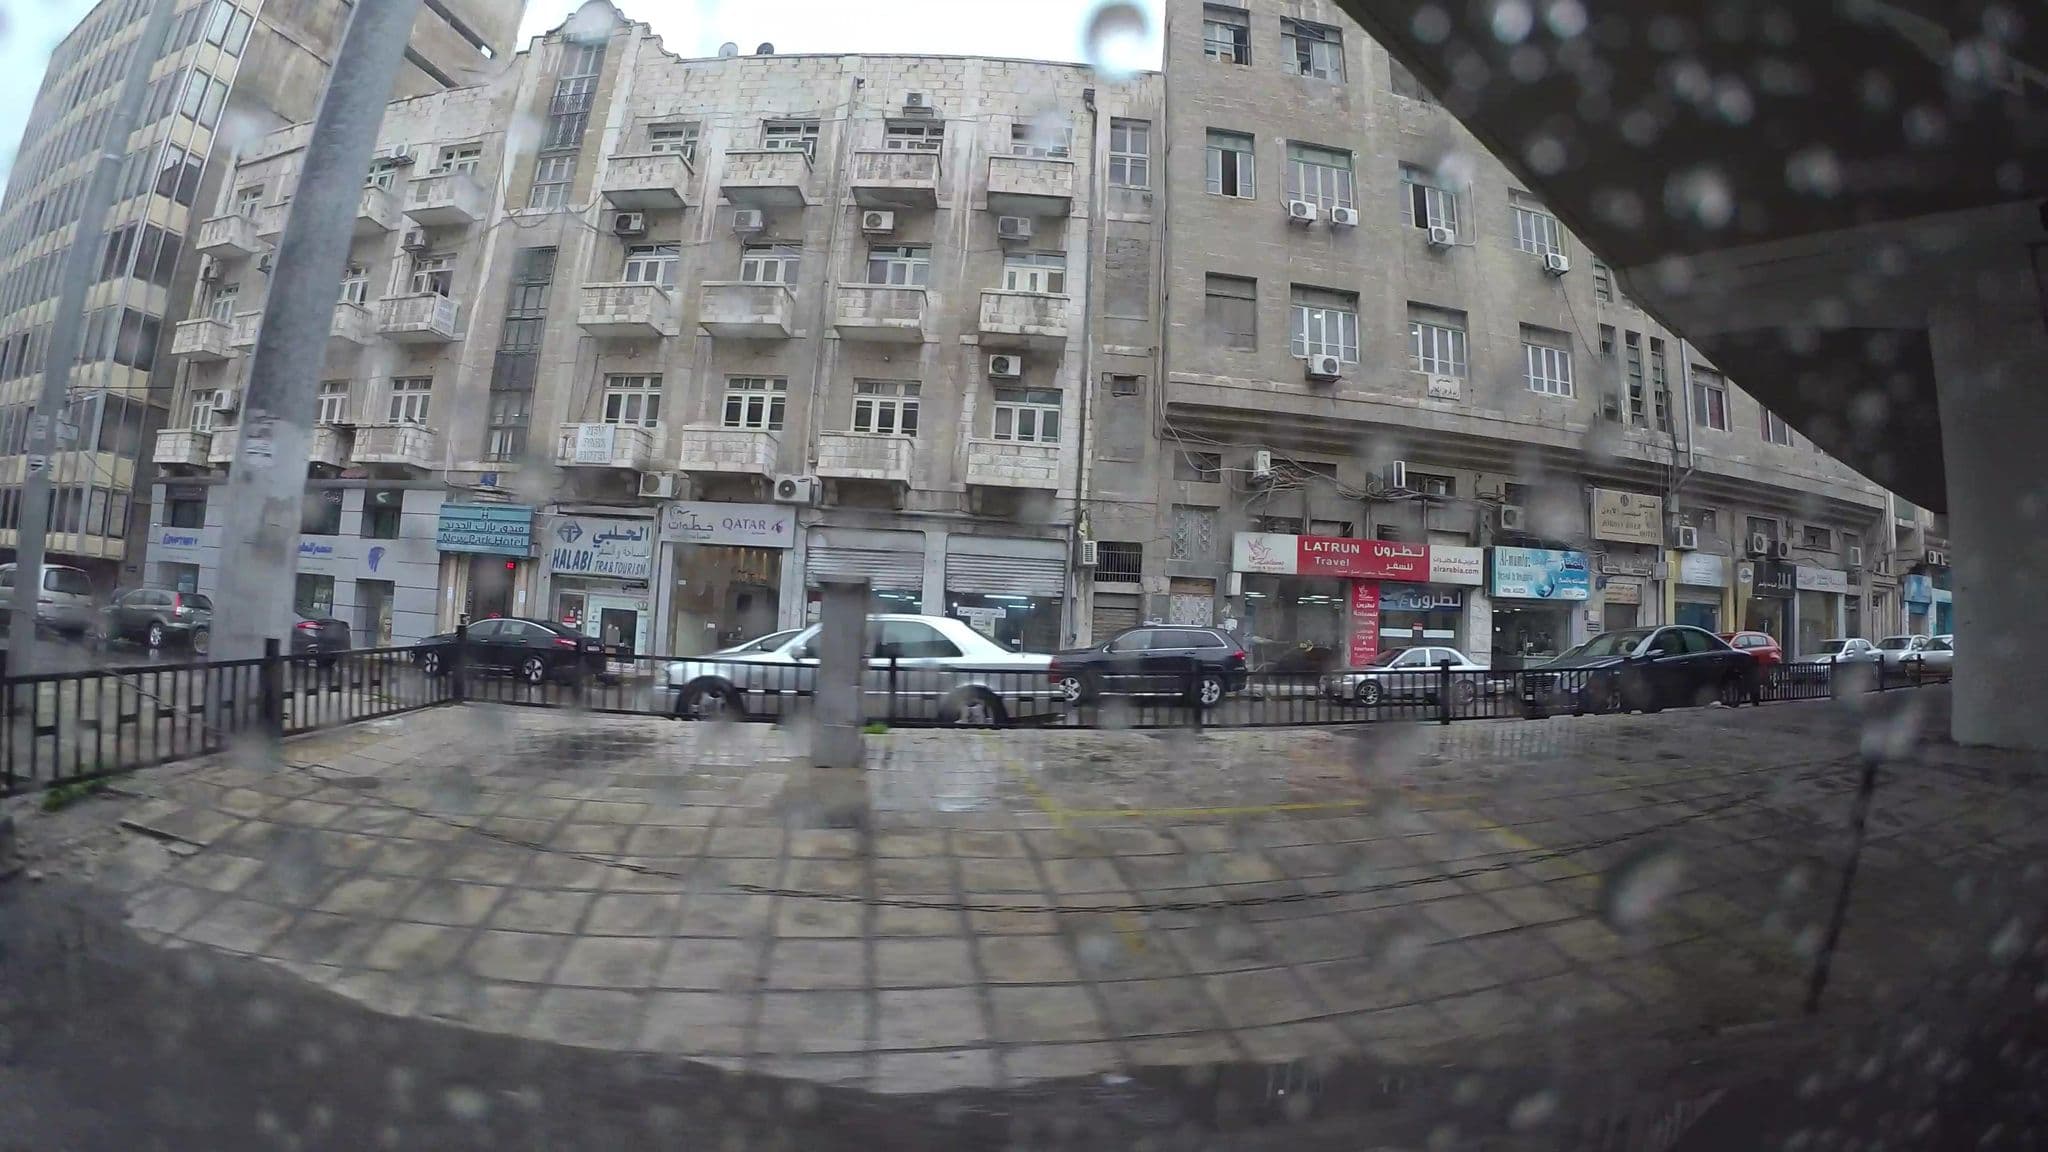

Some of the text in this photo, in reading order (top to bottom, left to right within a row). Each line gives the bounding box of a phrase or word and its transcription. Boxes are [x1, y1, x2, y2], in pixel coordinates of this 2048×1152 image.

[722, 518, 766, 530] QATAR
[442, 532, 524, 550] New Park Hotel
[592, 525, 650, 549] الحلبي
[1304, 540, 1361, 554] LATRUN
[1374, 543, 1425, 558] لطرون
[552, 547, 594, 571] HALABI
[1314, 556, 1350, 567] Travel
[1410, 591, 1462, 609] لطرون
